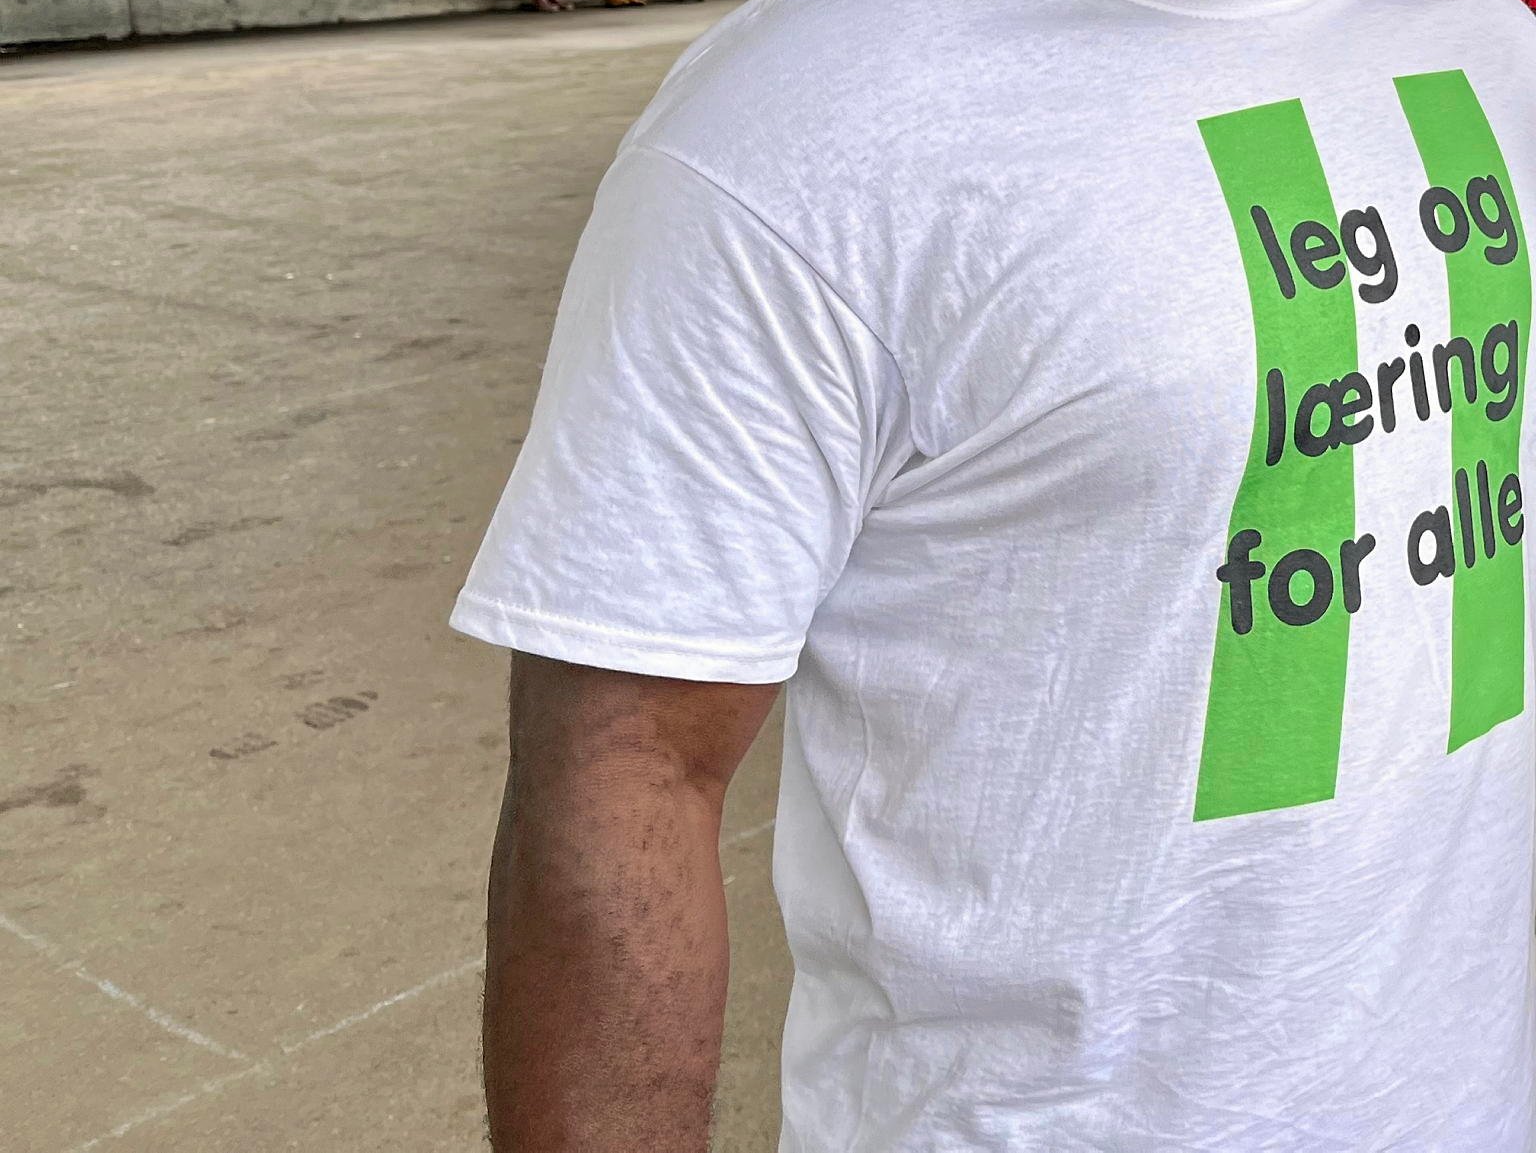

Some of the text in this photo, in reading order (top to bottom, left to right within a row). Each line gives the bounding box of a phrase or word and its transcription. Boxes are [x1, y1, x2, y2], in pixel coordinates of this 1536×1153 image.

[1250, 174, 1519, 304] leg og
[1265, 319, 1520, 468] læring
[1216, 459, 1526, 636] for alle
